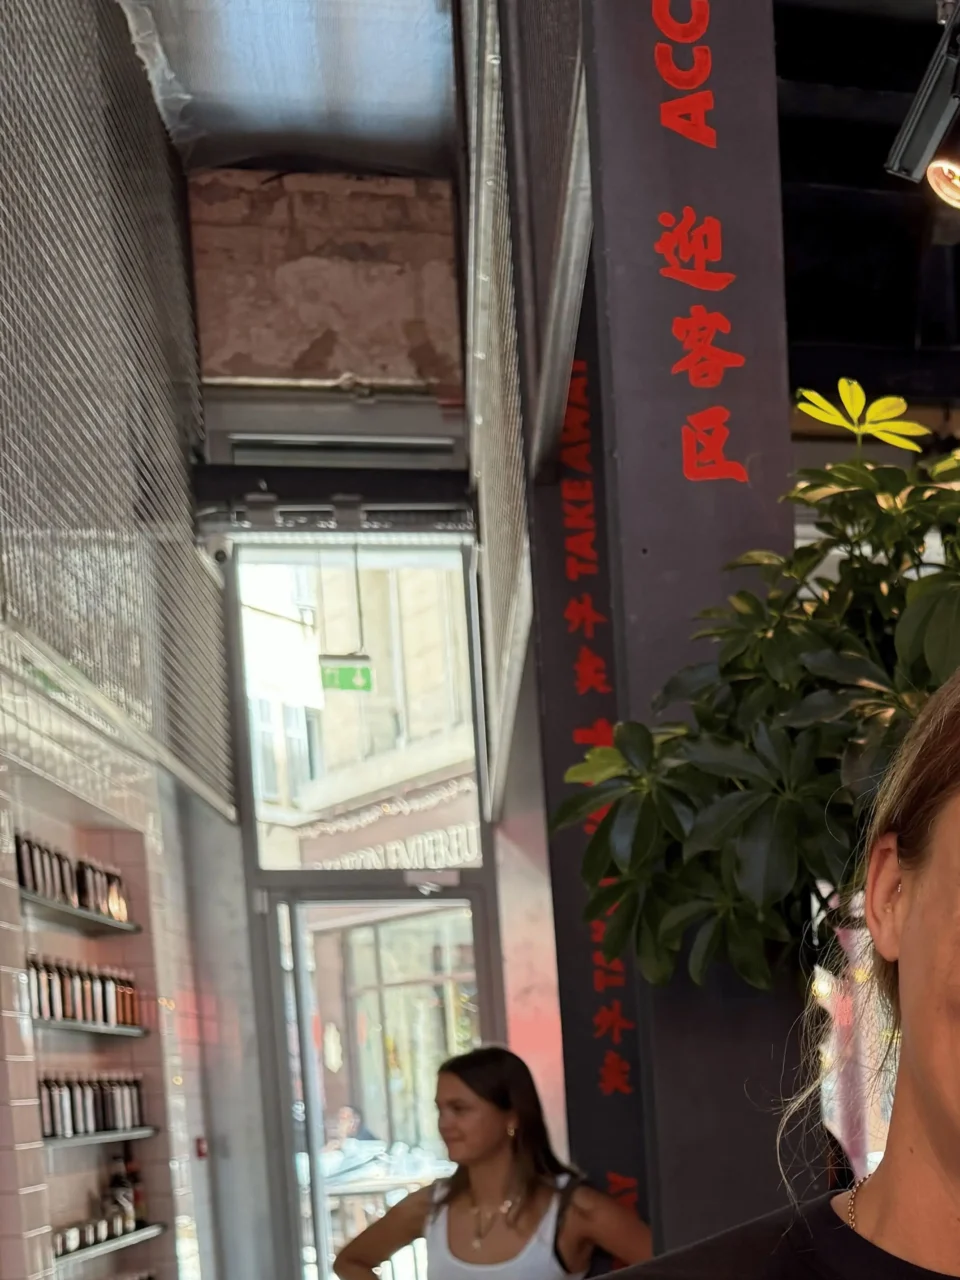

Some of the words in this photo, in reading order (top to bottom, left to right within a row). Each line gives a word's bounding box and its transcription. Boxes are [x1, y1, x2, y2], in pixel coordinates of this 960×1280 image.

[653, 205, 749, 482] 迎客区
[561, 478, 600, 581] TAKE
